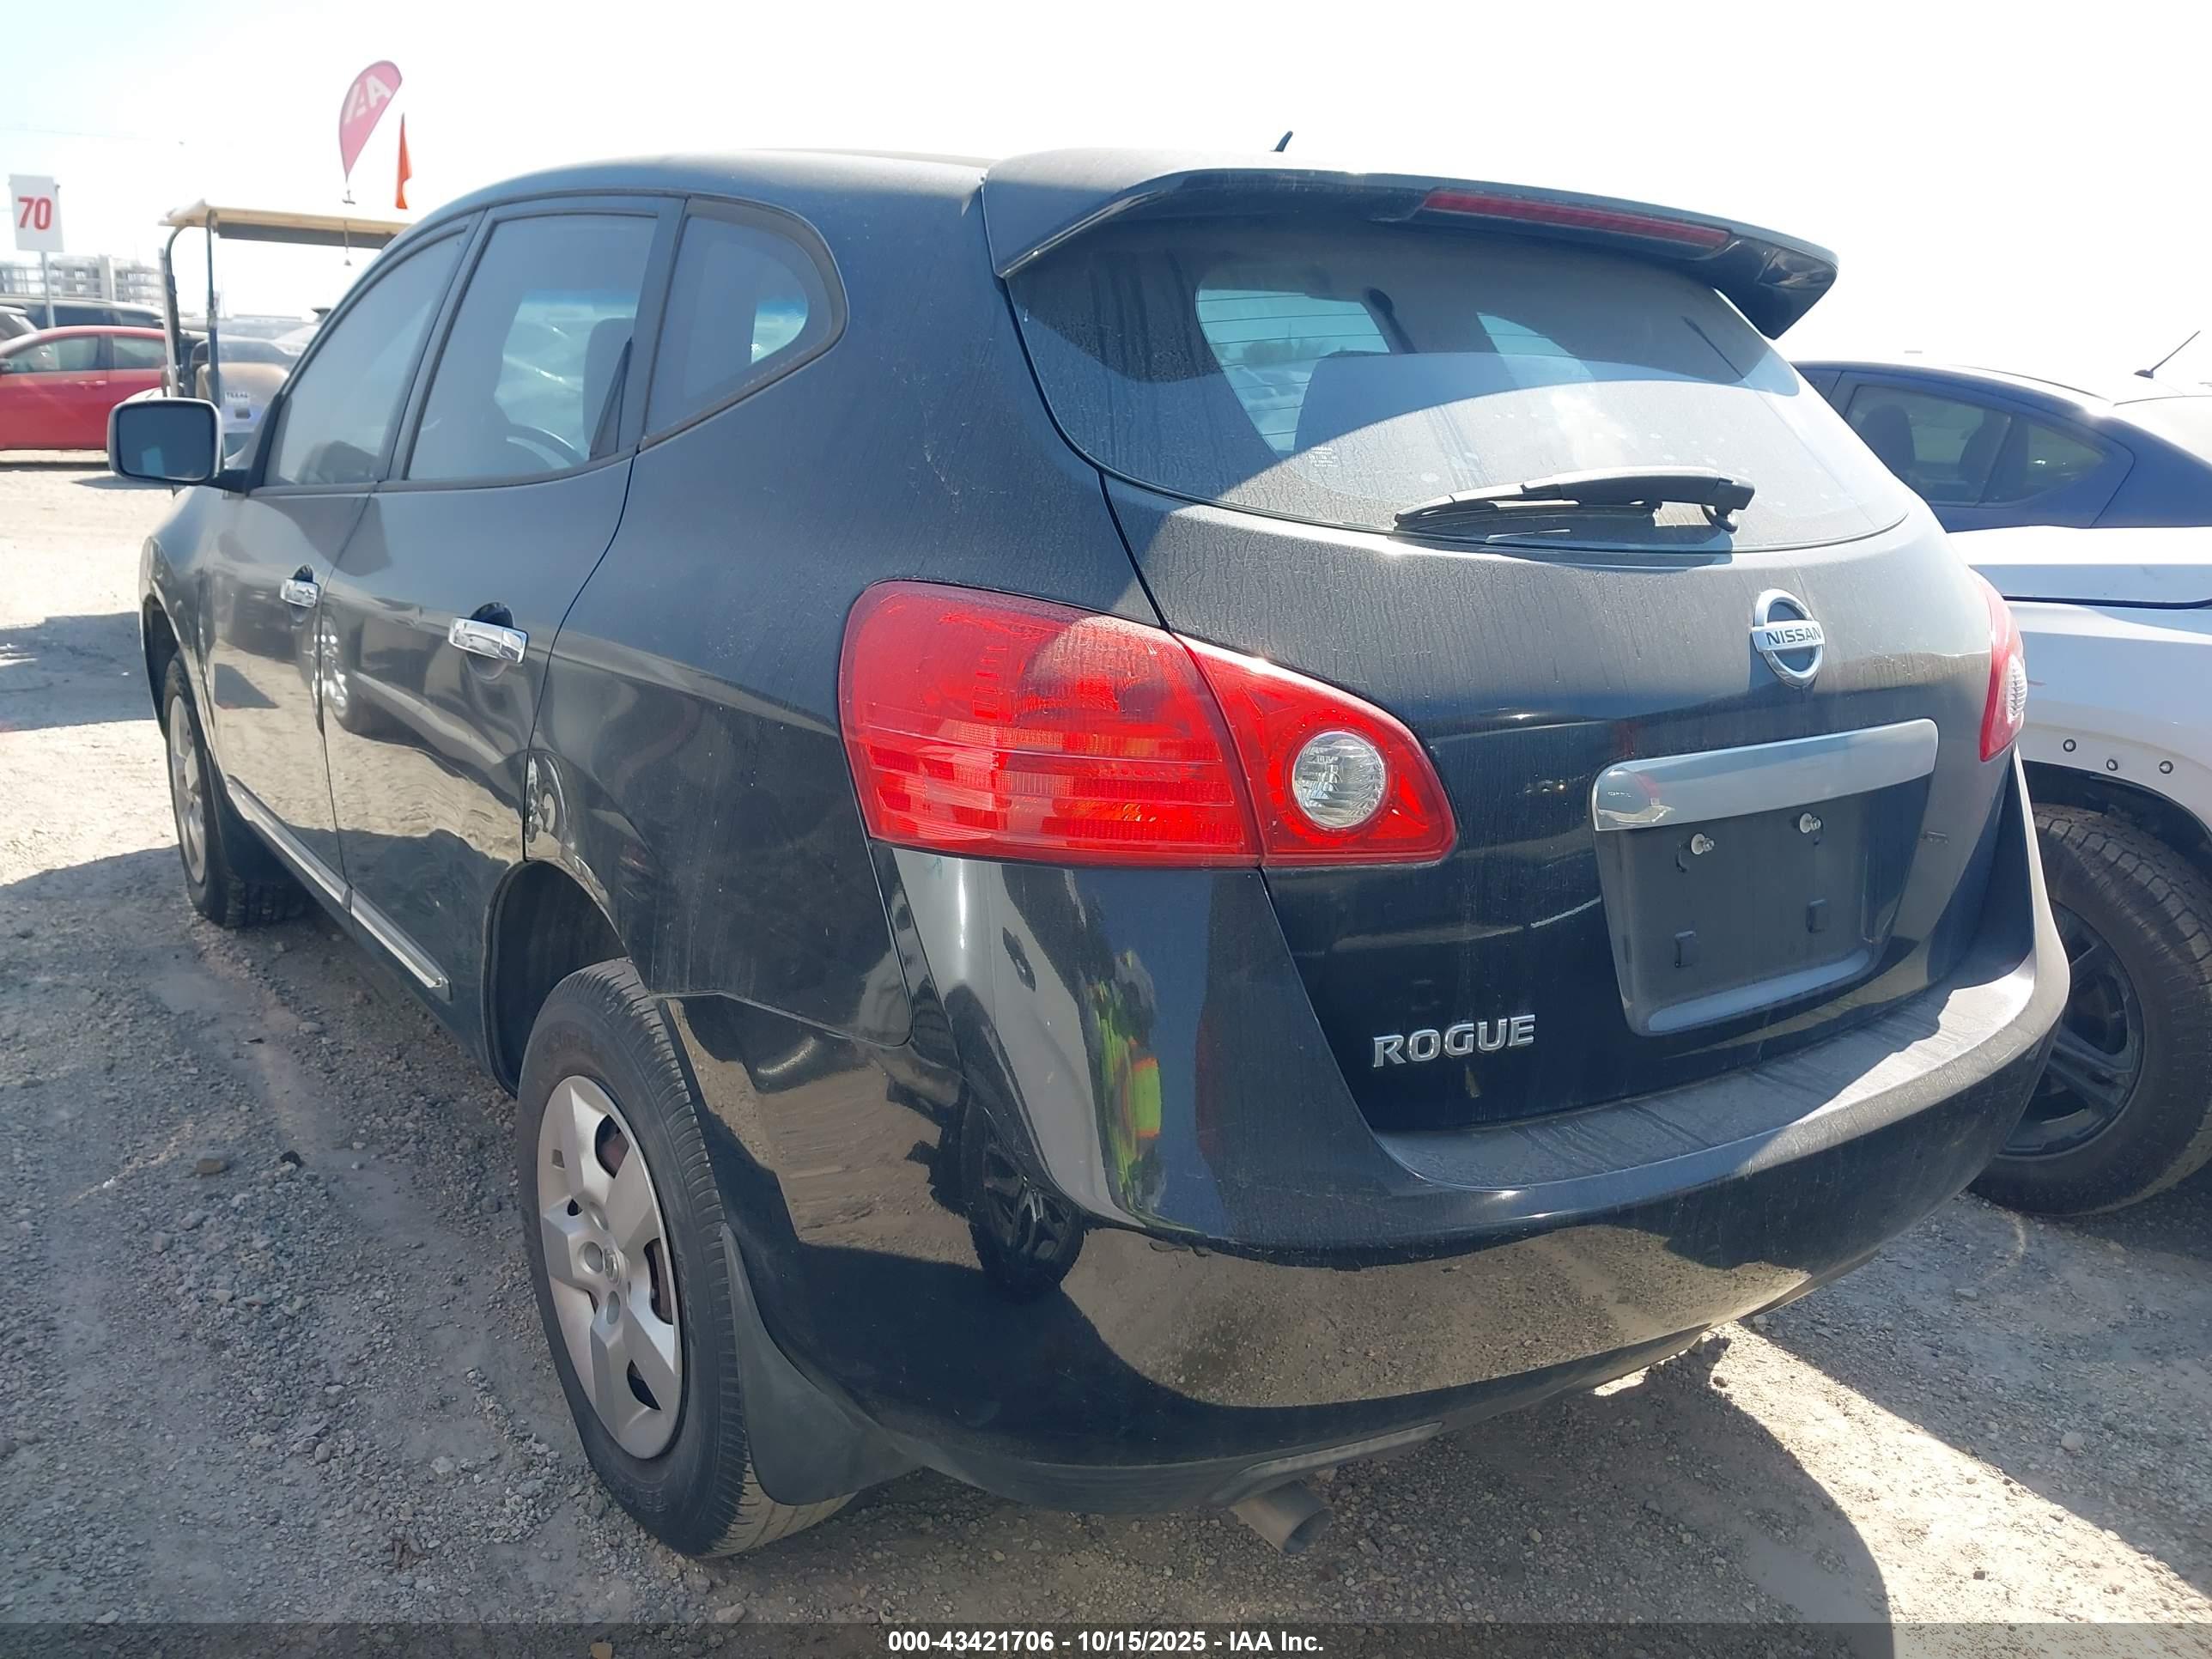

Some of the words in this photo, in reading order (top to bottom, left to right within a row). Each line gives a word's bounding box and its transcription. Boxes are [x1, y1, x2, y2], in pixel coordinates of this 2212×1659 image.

[18, 197, 52, 230] 70
[1765, 627, 1821, 646] NISSAN
[1373, 1014, 1535, 1067] ROGUE
